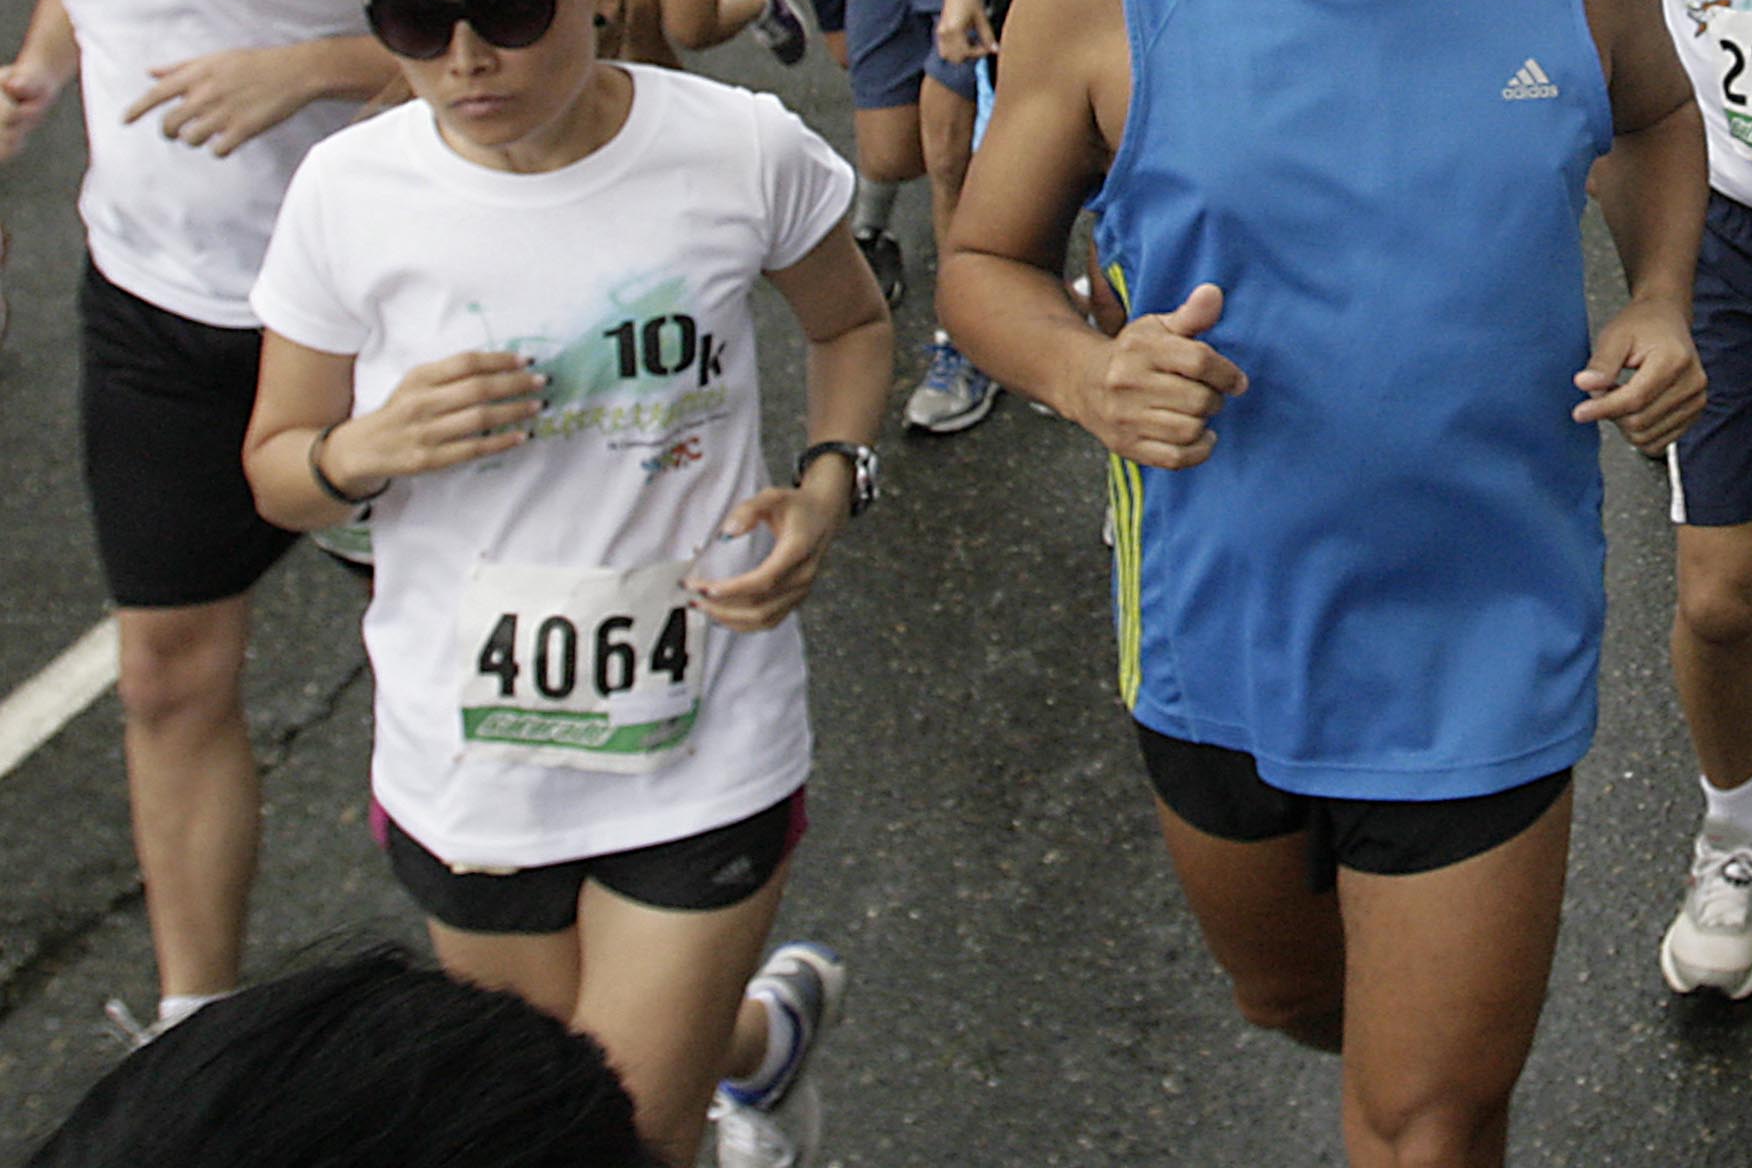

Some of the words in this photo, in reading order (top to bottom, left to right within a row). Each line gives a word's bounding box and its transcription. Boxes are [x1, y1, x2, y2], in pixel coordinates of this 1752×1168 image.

[1502, 84, 1558, 102] adidas
[602, 314, 726, 387] 10k
[477, 606, 689, 702] 4064
